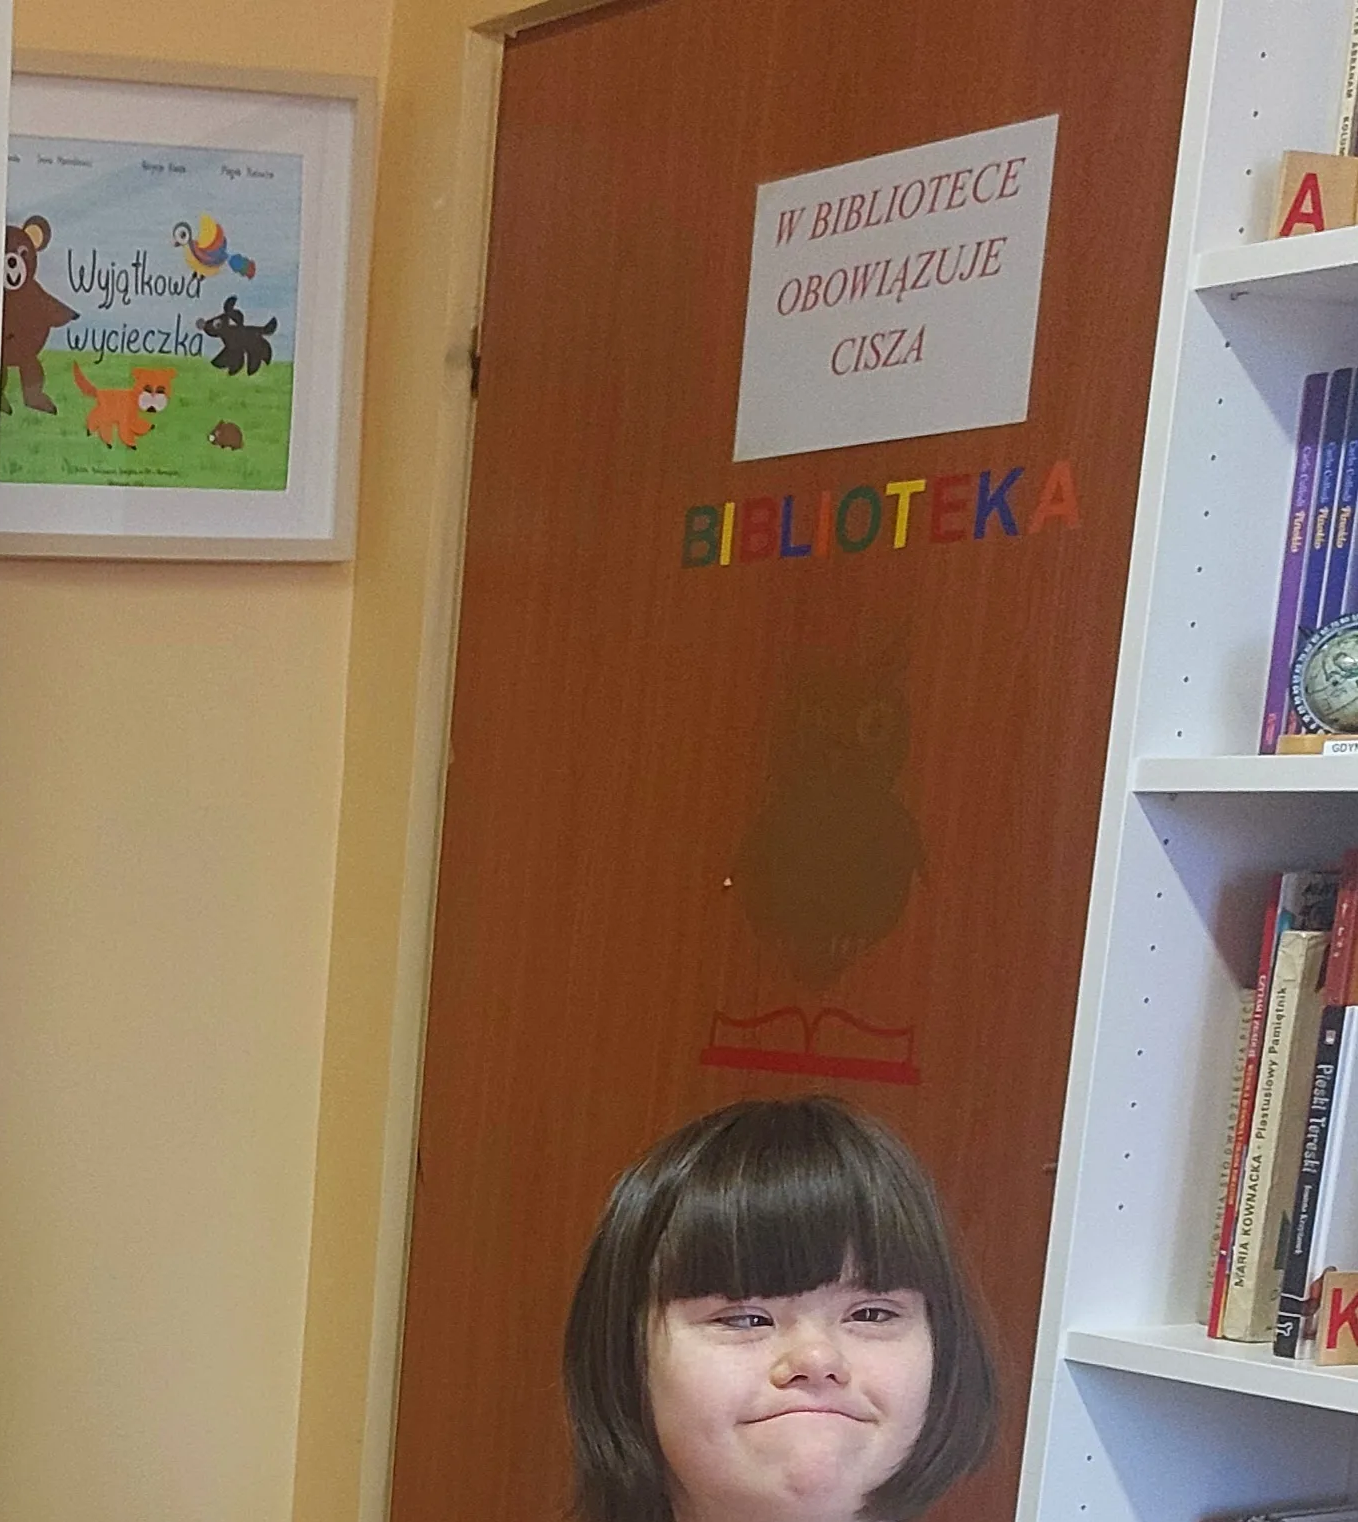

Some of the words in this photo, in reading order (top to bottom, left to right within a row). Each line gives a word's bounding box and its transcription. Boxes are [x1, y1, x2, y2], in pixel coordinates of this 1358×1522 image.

[775, 206, 806, 248] W
[808, 157, 1026, 240] BIBLIOTECE
[1280, 173, 1325, 236] A
[67, 248, 204, 309] Wyjątkowa
[777, 237, 1007, 316] OBOWIĄZUJE
[66, 314, 203, 363] wycieczka
[831, 325, 926, 376] CISZA
[683, 459, 1083, 568] BIBLIOTEKA
[1268, 987, 1287, 1055] Pamiętnik
[1255, 1059, 1279, 1140] Plastusiowy
[1311, 1064, 1335, 1110] Pieski
[1301, 1117, 1327, 1173] Tereski
[1241, 1154, 1263, 1237] KOWNACKA
[1233, 1241, 1250, 1287] MARIA
[1326, 1286, 1358, 1350] K
